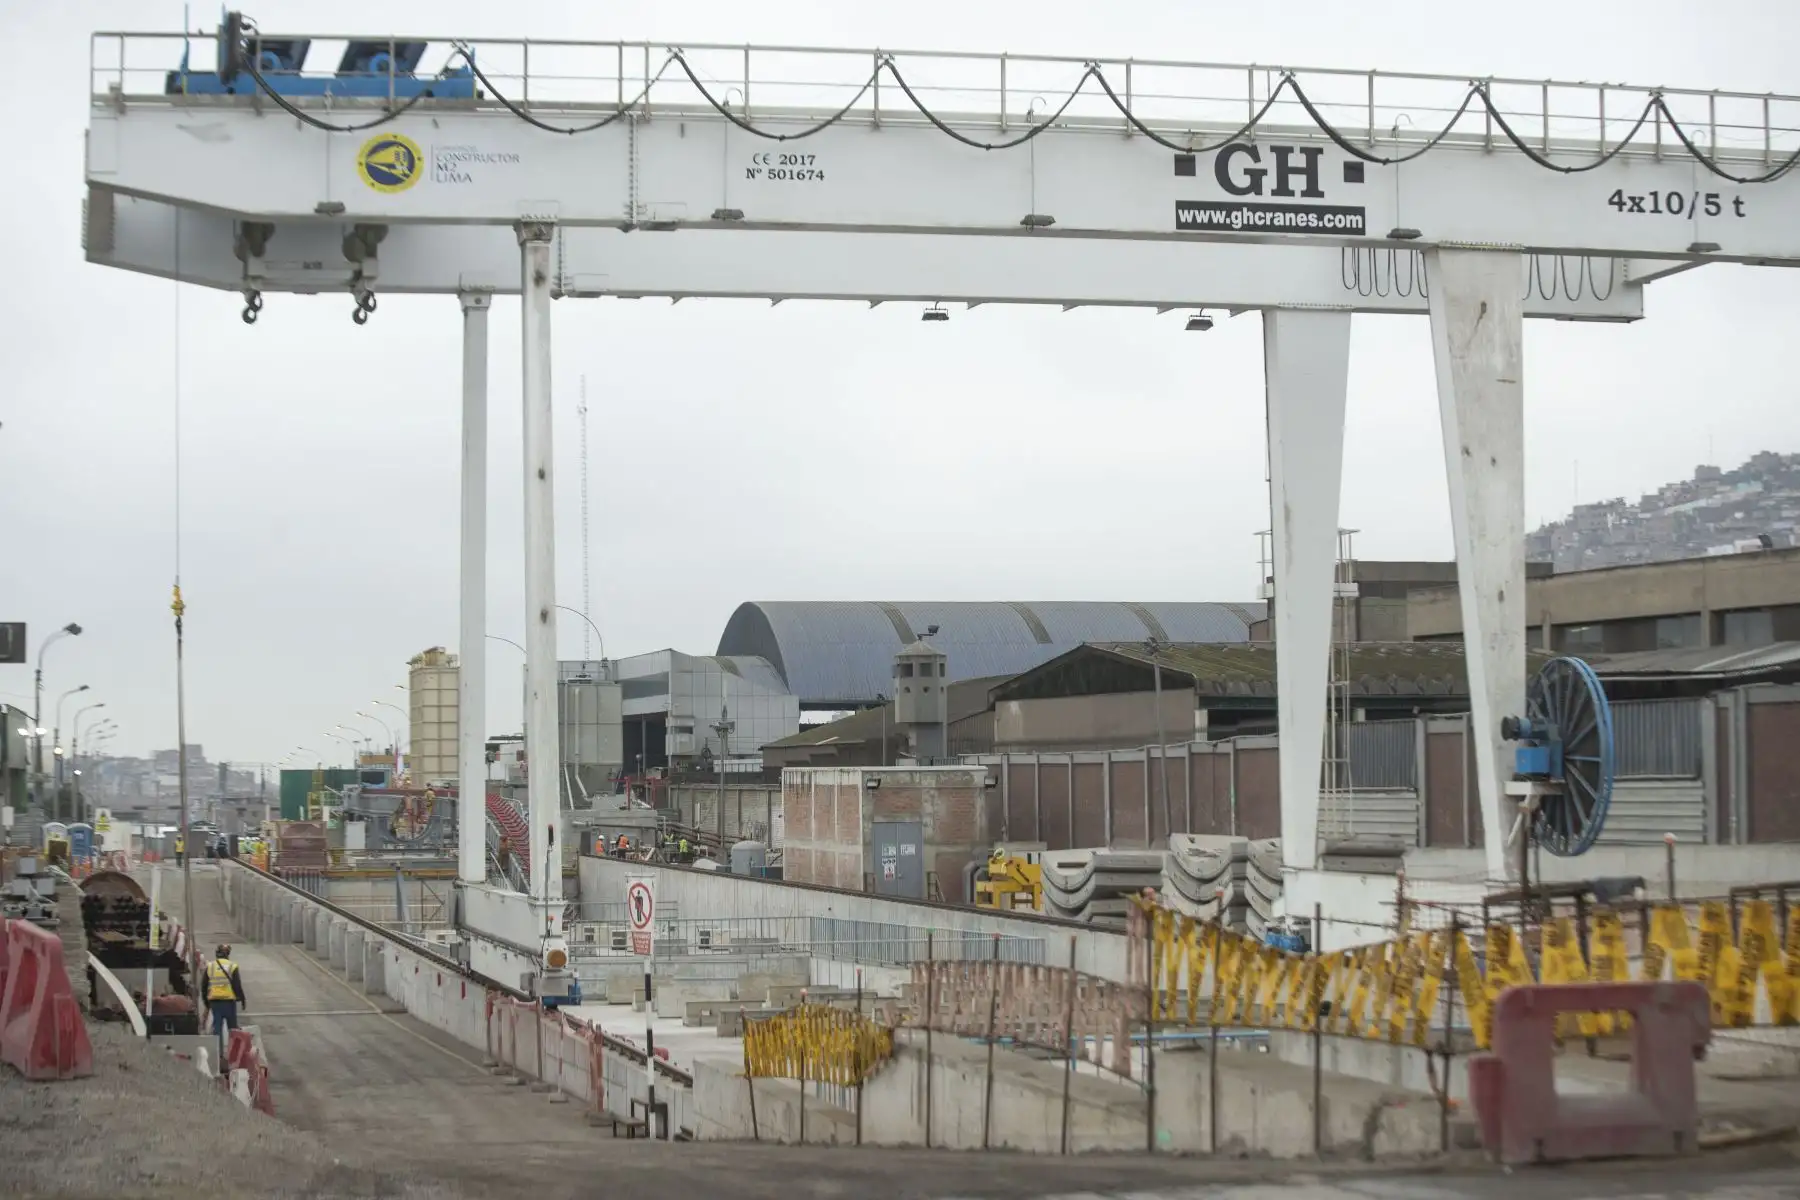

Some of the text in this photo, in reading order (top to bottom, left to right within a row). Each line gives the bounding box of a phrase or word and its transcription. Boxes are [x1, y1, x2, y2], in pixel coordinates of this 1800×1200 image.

[436, 152, 520, 164] CONSTRUCTOR
[779, 154, 816, 166] 2017
[436, 162, 457, 172] M2
[1214, 142, 1325, 198] GH
[436, 172, 472, 183] LIMA
[767, 168, 825, 181] 501674
[1732, 195, 1746, 217] t
[1178, 207, 1363, 229] www.ghcranes.com
